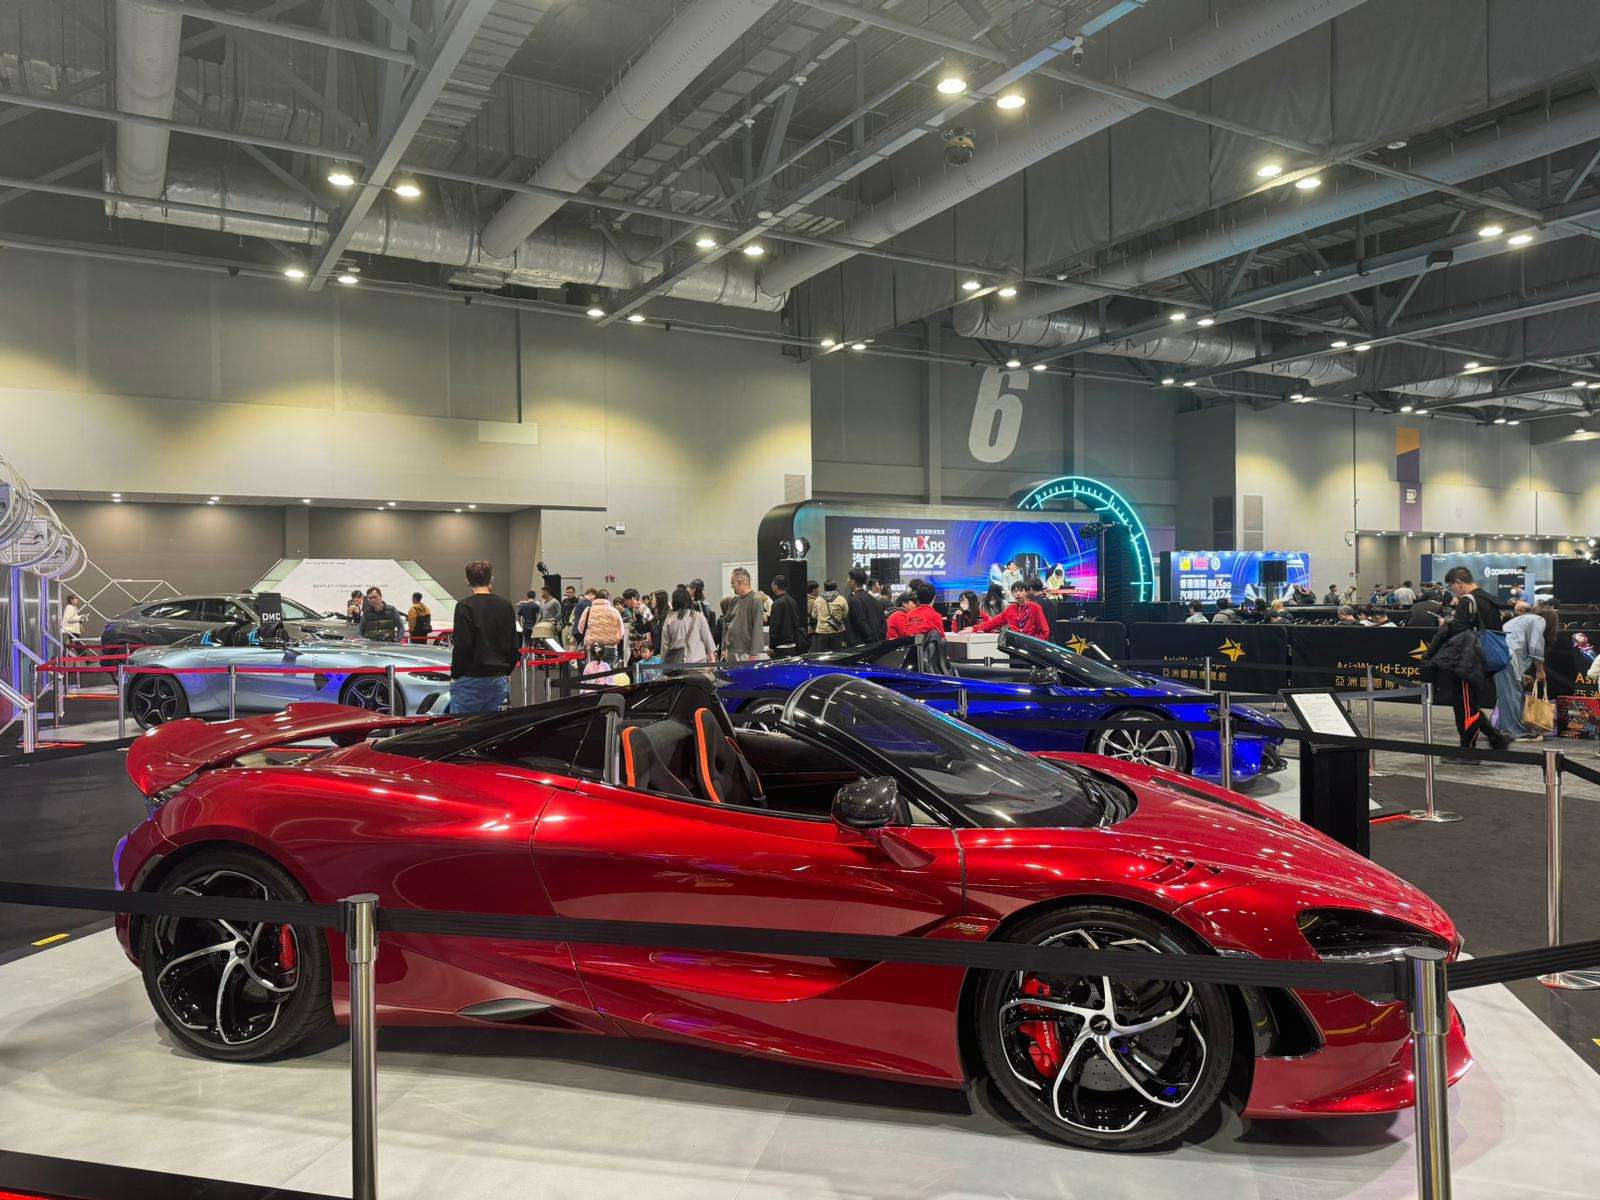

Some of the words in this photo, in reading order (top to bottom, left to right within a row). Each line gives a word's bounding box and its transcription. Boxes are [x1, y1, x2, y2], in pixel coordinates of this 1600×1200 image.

[968, 366, 1030, 463] 6
[852, 534, 900, 550] 香港國際
[902, 553, 946, 568] 2024
[1207, 590, 1232, 600] 2024
[262, 612, 281, 621] DMC
